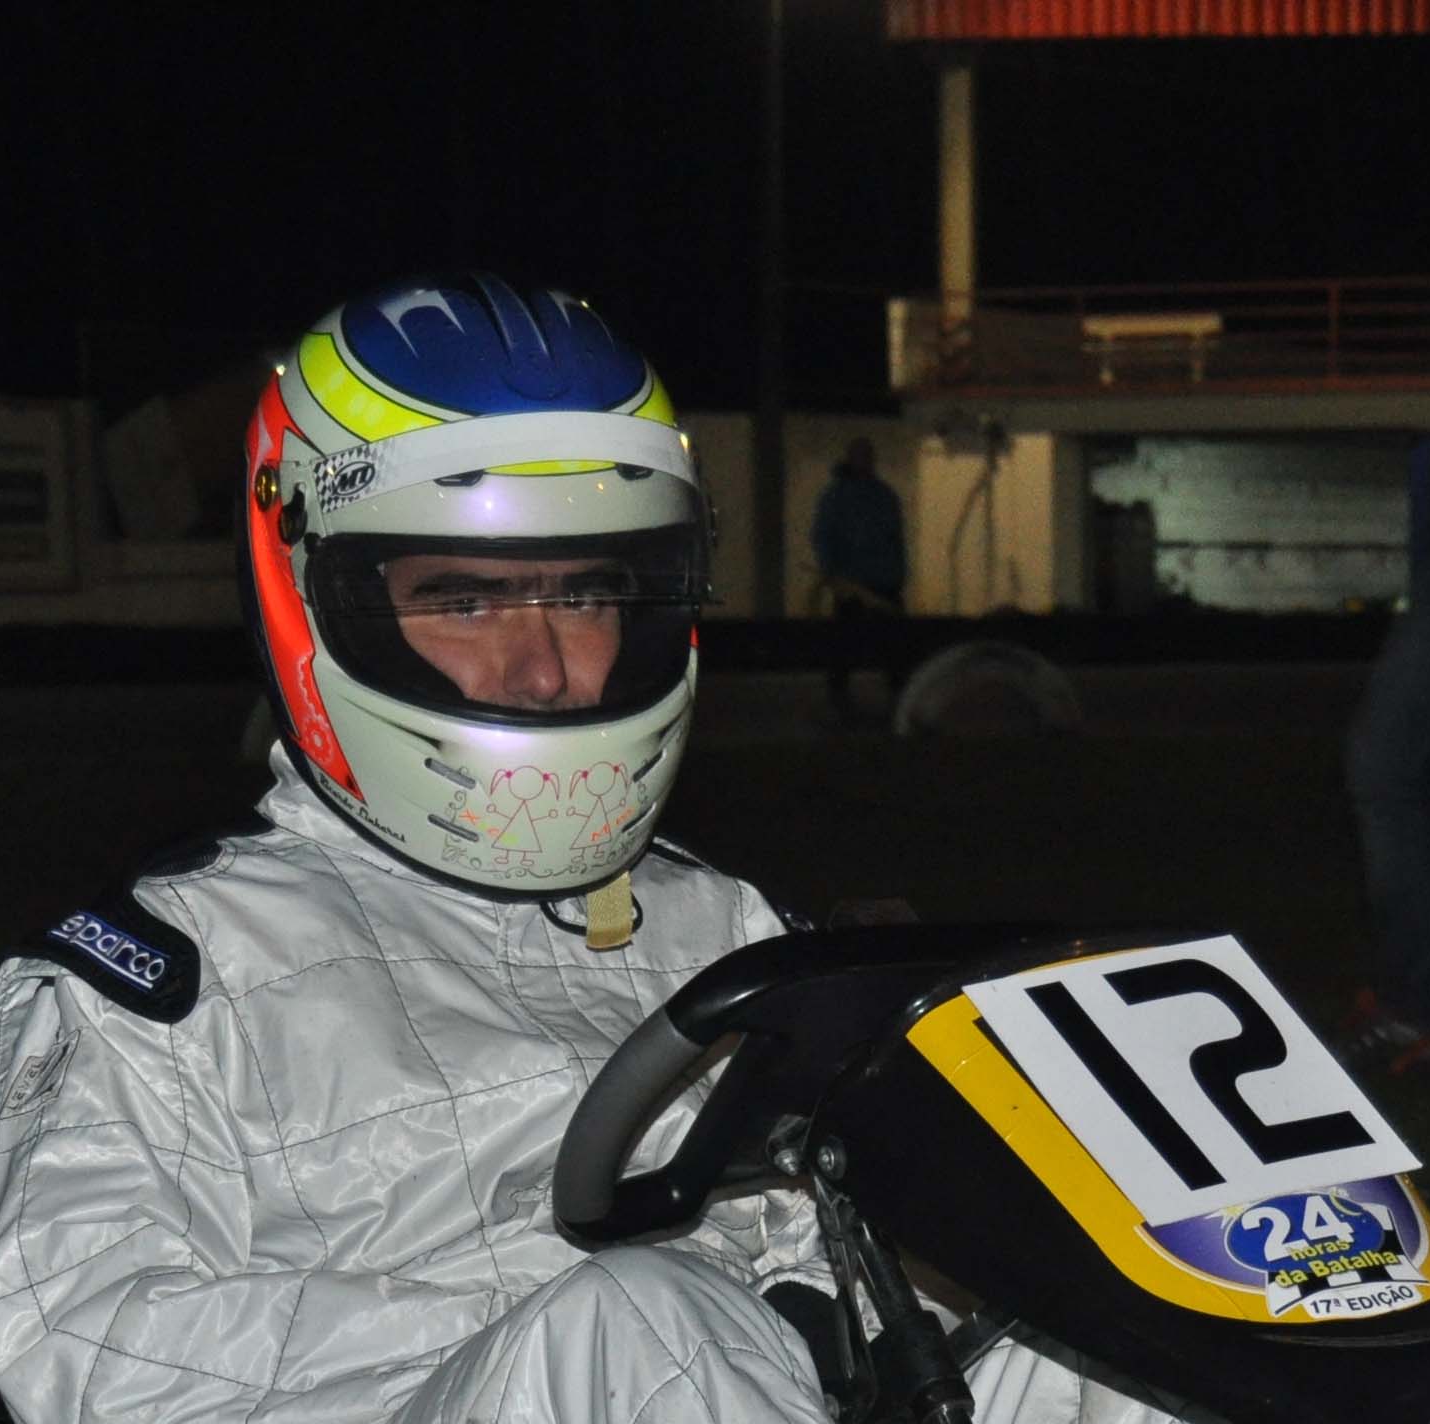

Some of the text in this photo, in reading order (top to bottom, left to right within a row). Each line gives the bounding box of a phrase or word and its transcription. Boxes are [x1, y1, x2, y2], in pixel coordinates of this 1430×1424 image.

[60, 914, 165, 982] sparco
[1024, 958, 1376, 1191] 12
[1240, 1195, 1354, 1262] 24
[1285, 1239, 1351, 1261] horas
[1274, 1249, 1400, 1289] da Batalha
[1348, 1284, 1414, 1312] EDIÇÃO
